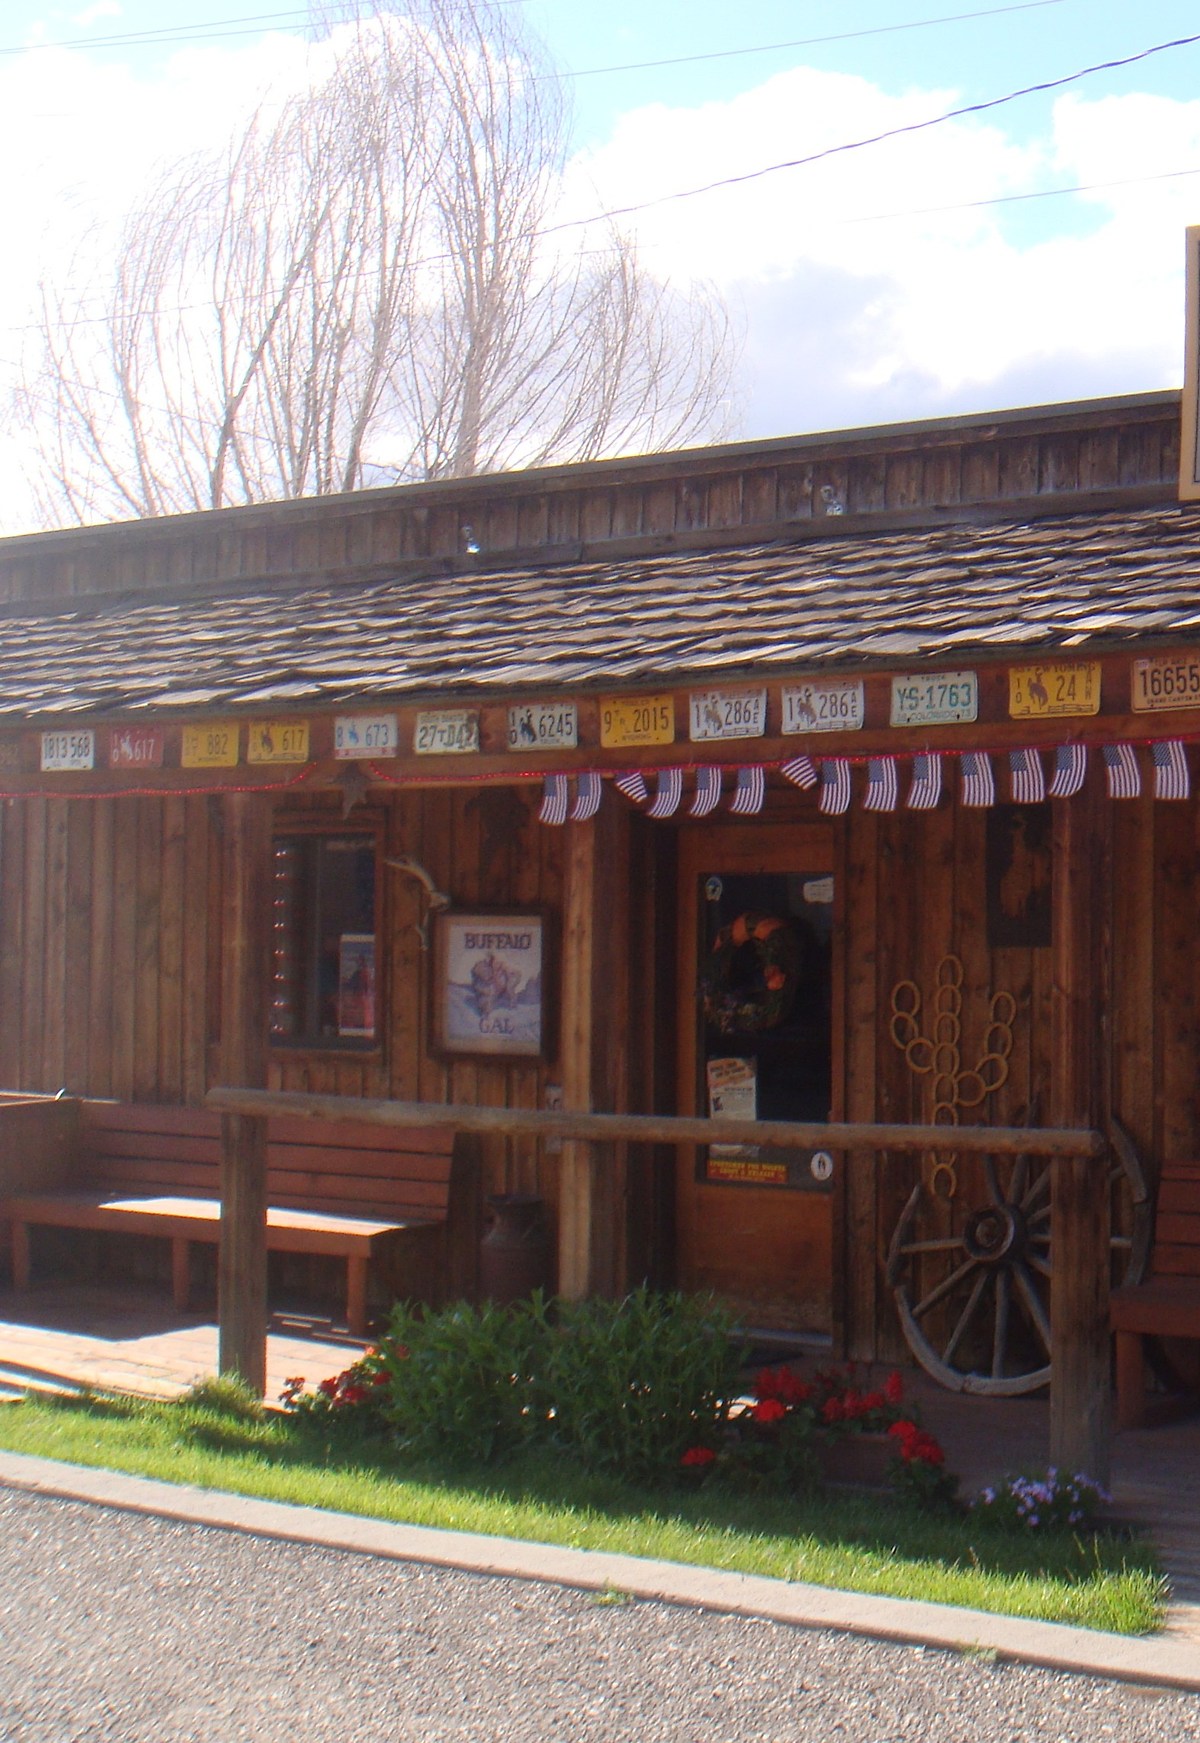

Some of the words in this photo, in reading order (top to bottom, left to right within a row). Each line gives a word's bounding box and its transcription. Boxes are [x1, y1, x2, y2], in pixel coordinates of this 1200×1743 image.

[1056, 674, 1076, 701] 24
[725, 699, 751, 726] 286
[819, 692, 848, 719] 286
[539, 713, 573, 738] 6245
[633, 706, 669, 733] 2015
[283, 729, 304, 751] 617
[365, 724, 389, 746] 673
[134, 739, 155, 761] 617
[464, 932, 532, 950] BUFFALO
